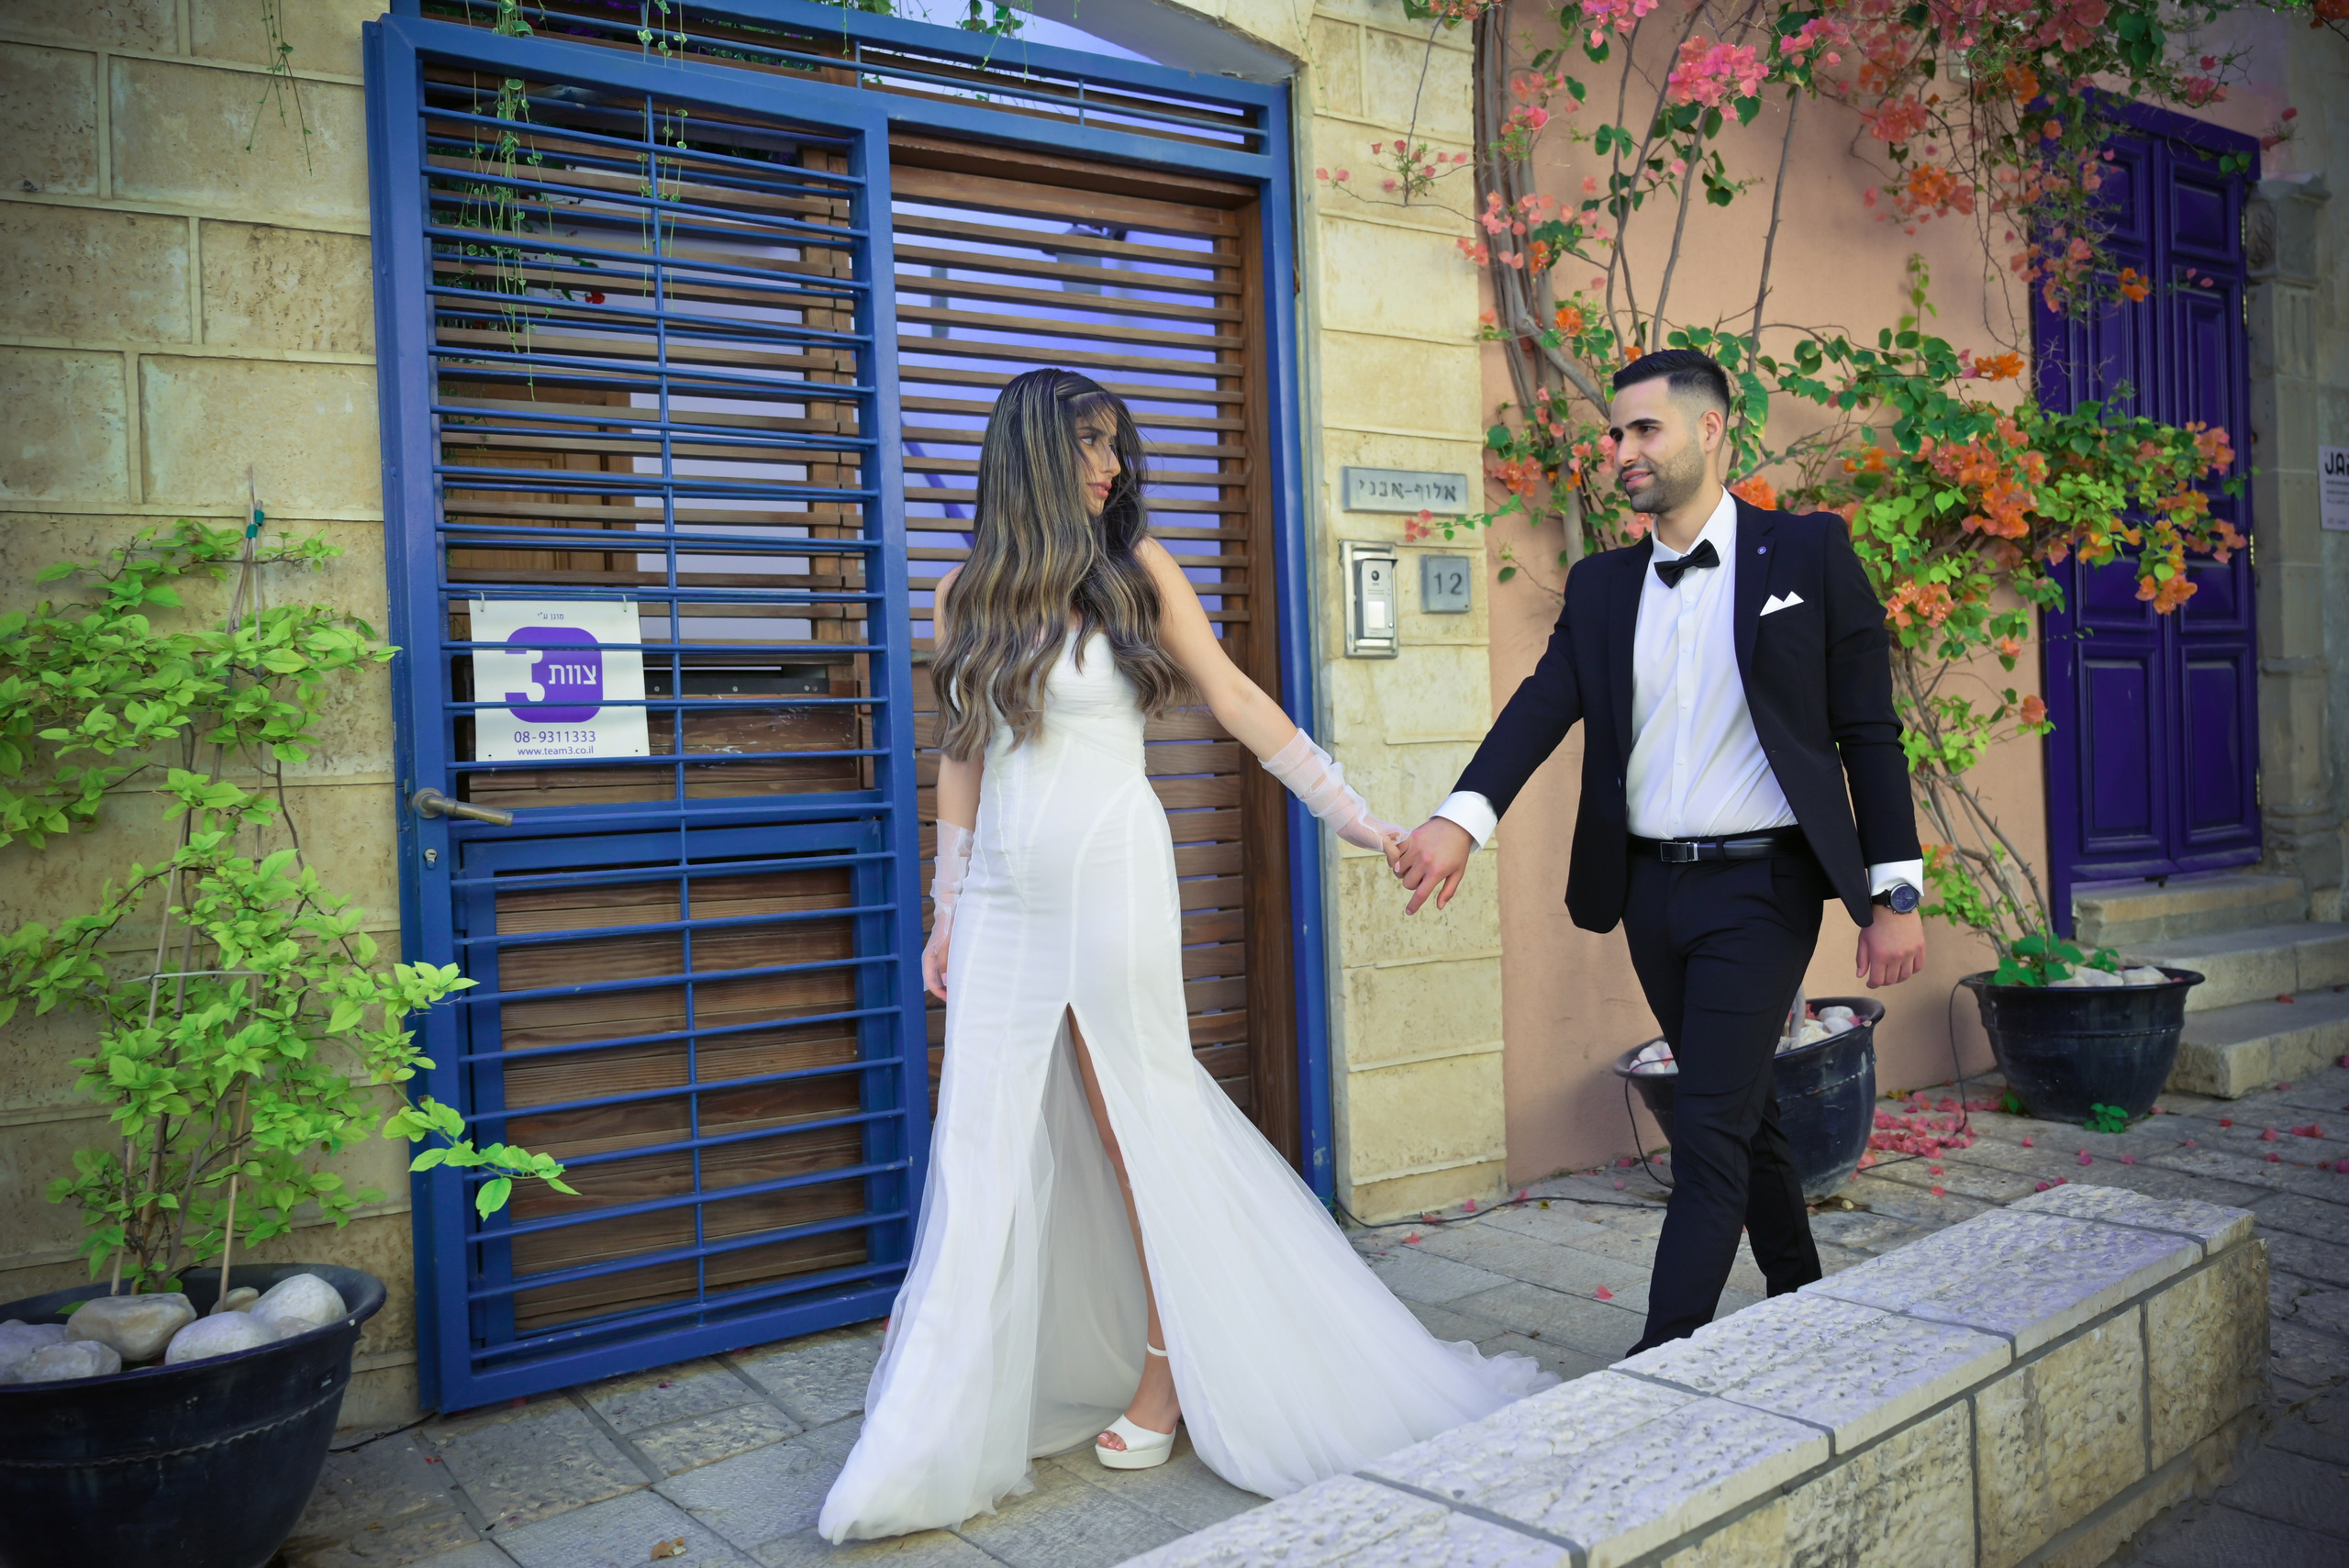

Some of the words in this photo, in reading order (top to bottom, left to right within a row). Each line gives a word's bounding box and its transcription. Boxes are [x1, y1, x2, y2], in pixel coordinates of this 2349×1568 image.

[2325, 452, 2349, 476] JA
[1433, 572, 1463, 595] 12
[548, 664, 596, 684] צוות
[514, 730, 596, 743] 08-9311333
[518, 745, 594, 756] www.team3.co.il
